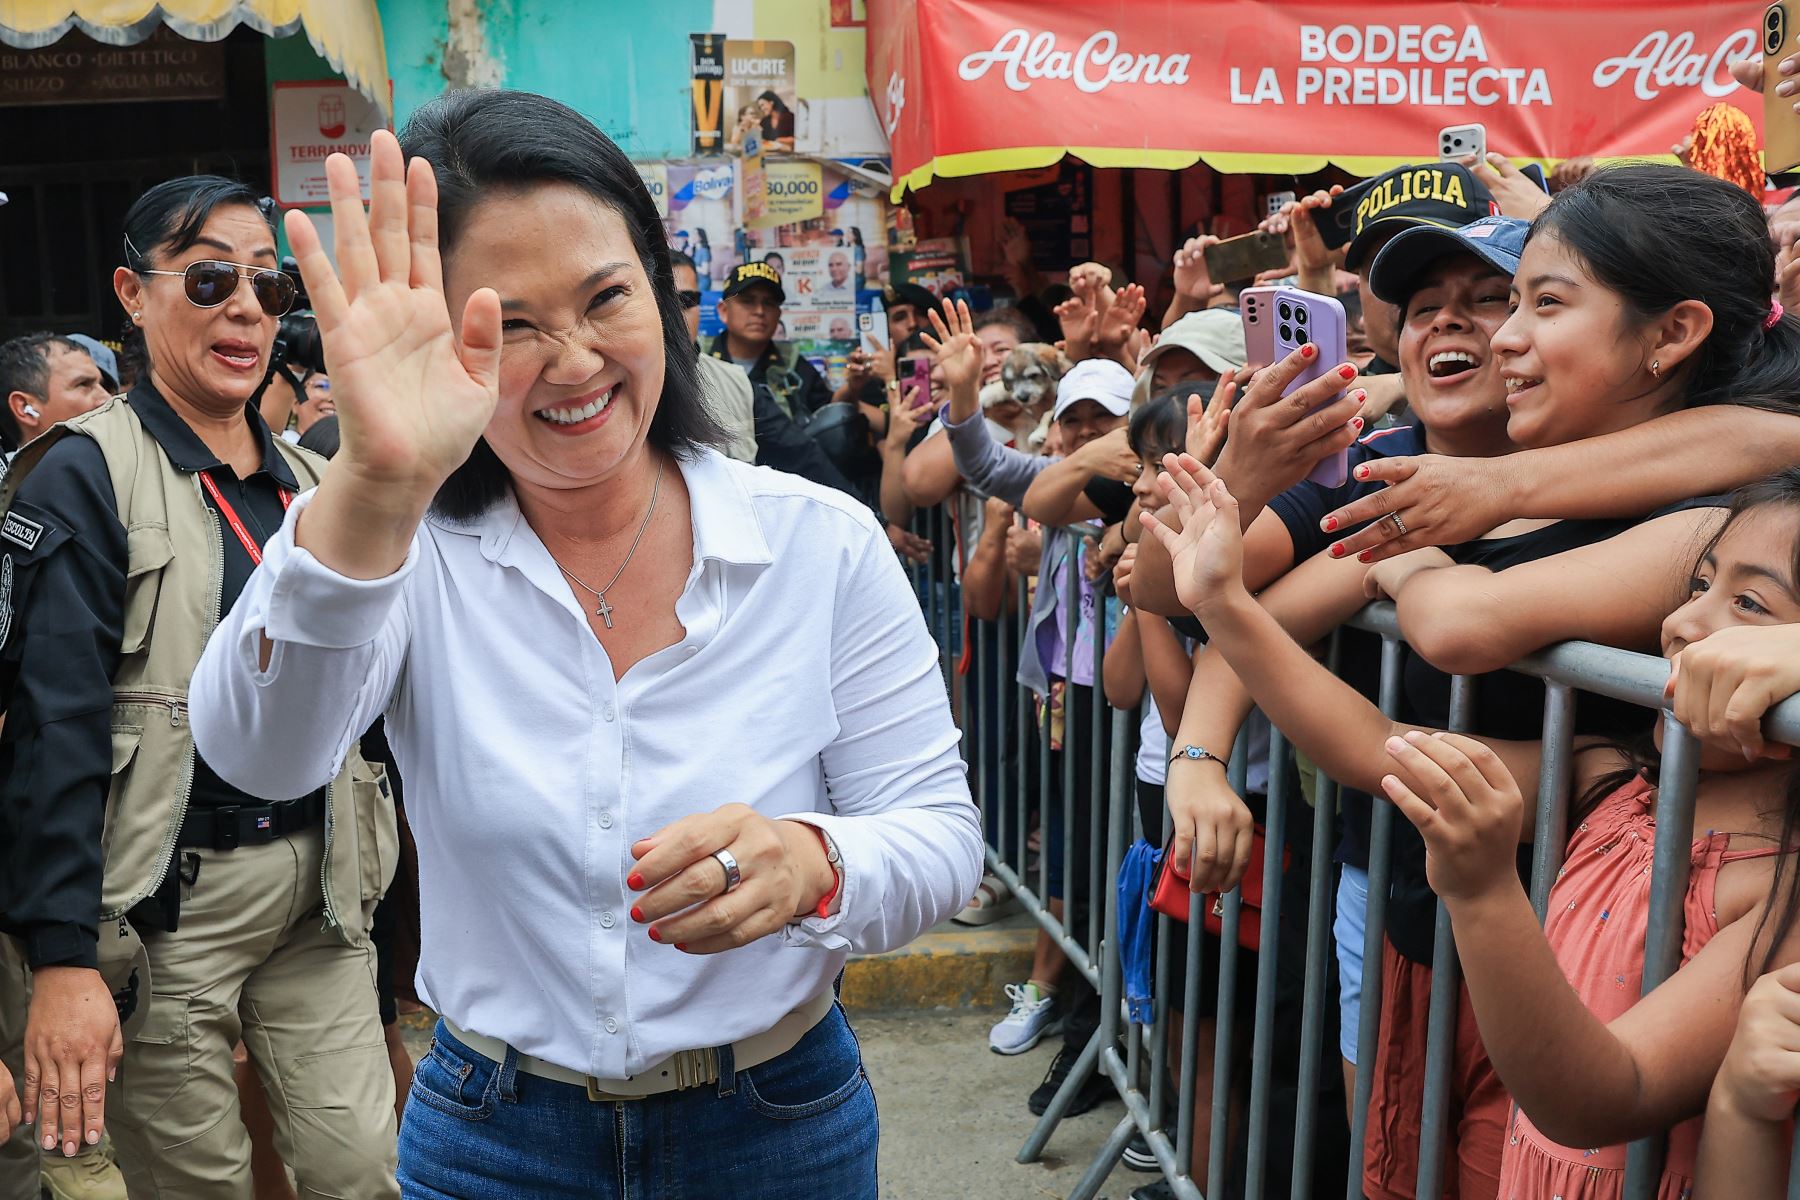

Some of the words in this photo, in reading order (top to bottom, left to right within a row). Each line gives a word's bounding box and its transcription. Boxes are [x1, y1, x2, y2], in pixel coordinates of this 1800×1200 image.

[1299, 24, 1489, 63] BODEGA
[2, 51, 82, 70] BLANCO
[731, 58, 786, 76] LUCIRTE
[957, 28, 1191, 93] AlaCena
[1592, 28, 1763, 100] AlaC
[1229, 67, 1284, 104] LA
[1296, 67, 1553, 106] PREDILECTA
[289, 144, 371, 158] TERRANOV
[1356, 169, 1467, 236] POLICIA
[737, 262, 780, 283] POLICIA
[4, 518, 36, 543] ESCOLTA
